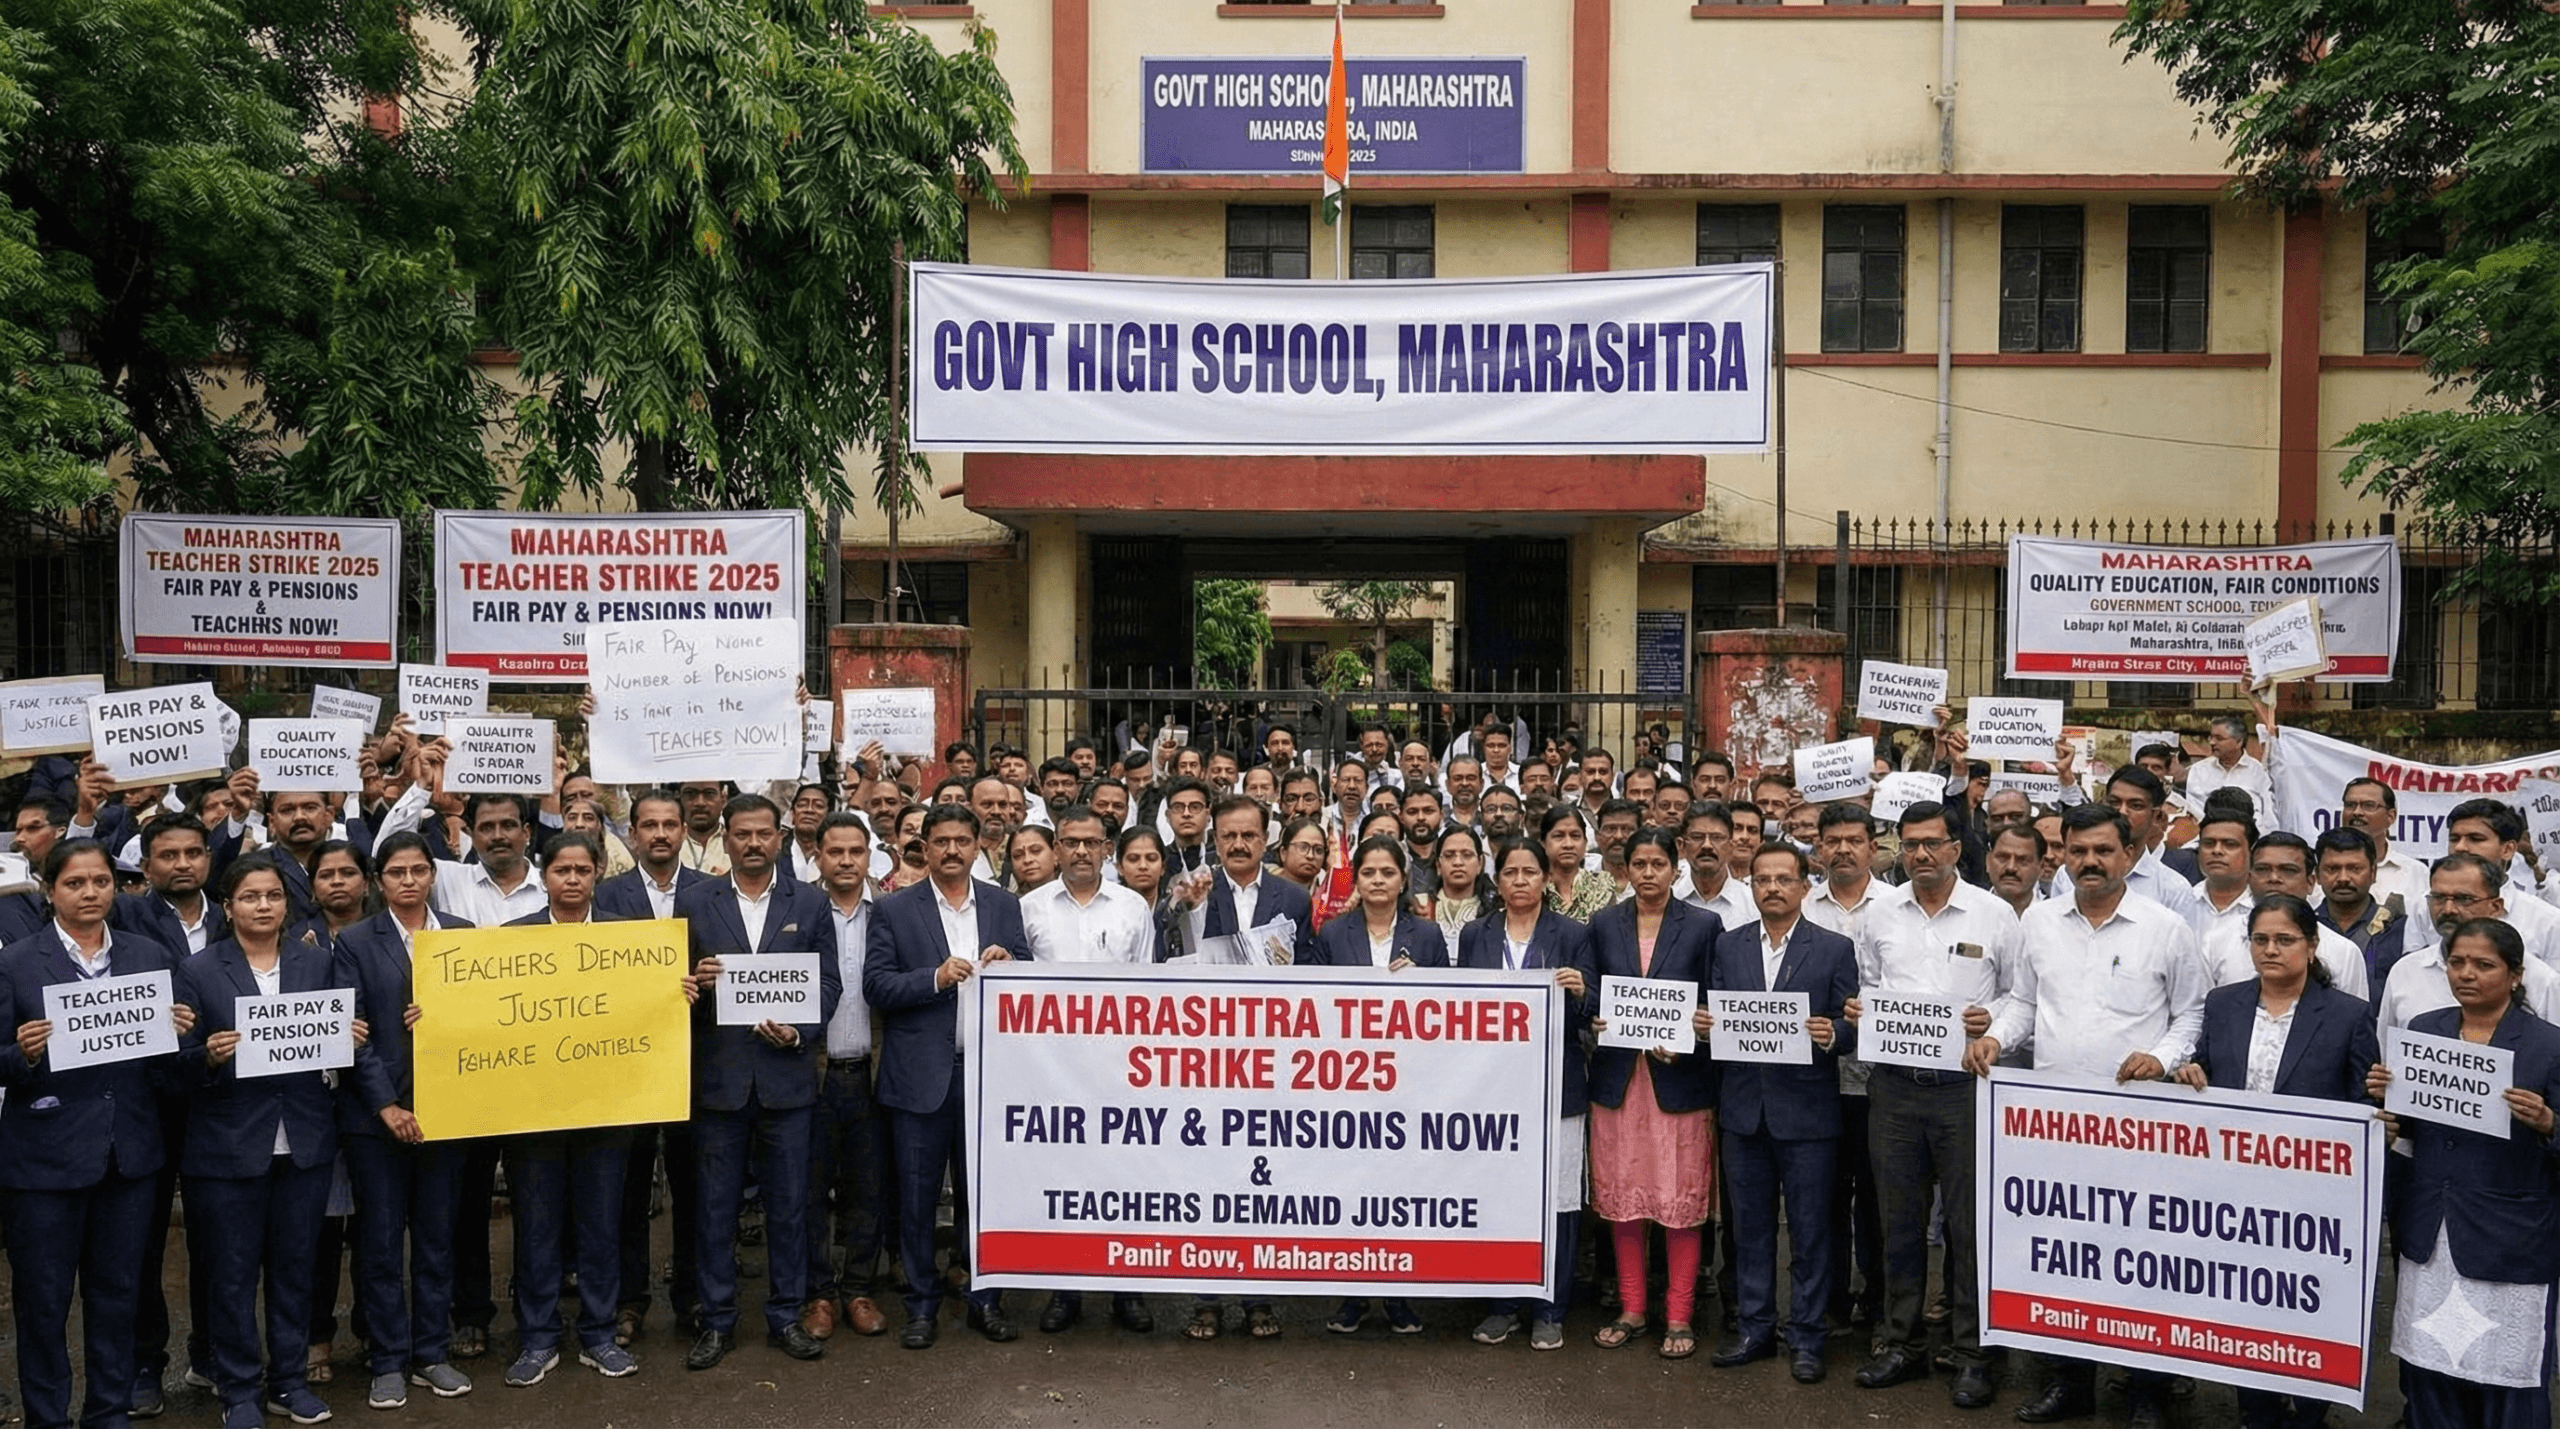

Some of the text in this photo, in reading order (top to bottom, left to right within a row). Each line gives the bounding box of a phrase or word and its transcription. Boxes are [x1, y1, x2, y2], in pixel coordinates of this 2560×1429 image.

[1154, 74, 1207, 107] GOVT
[1215, 75, 1264, 107] HIGH
[1362, 74, 1513, 108] MAHARASHTRA
[1375, 121, 1418, 141] INDIA
[933, 319, 1748, 402] GOVT HIGH SCHOOL, MAHARASHTRA
[184, 528, 341, 551] MAHARASHTRA
[510, 528, 727, 556] MAHARASHTRA
[146, 551, 379, 577] TEACHER STRIKE 2025
[2101, 552, 2312, 571] MAHARASHTRA
[459, 562, 780, 591] TEACHER STRIKE 2025
[2030, 574, 2380, 598] QUALITY EDUCATION, FAIR CONDITIONS
[164, 578, 358, 600] FAIR PAY & PENSIONS
[256, 600, 267, 615] &
[472, 602, 772, 622] FAIR PAY & PENSIONS NOW!
[2090, 599, 2181, 612] GOVERNMENT
[289, 618, 338, 636] NOW!
[407, 675, 479, 690] TEACHERS
[99, 694, 206, 721] FAIR PAY &
[412, 694, 472, 706] DEMAND
[719, 698, 744, 712] the
[1878, 699, 1923, 714] JUSTICE
[1989, 707, 2038, 718] QUALITY
[105, 719, 205, 745] PENSIONS
[277, 731, 336, 744] QUALITY
[647, 730, 722, 753] TEACHES
[734, 722, 787, 746] NOW!
[1979, 721, 2046, 733] EDUCATION,
[129, 745, 188, 767] NOW!
[260, 748, 351, 761] EDUCATIONS,
[458, 773, 542, 785] CONDITIONS
[433, 943, 677, 983] TEACHERS DEMAND
[727, 970, 809, 985] TEACHERS
[59, 983, 157, 1010] TEACHERS
[735, 990, 806, 1005] DEMAND
[1612, 984, 1686, 1003] TEACHERS
[248, 999, 344, 1020] FAIR PAY &
[498, 993, 610, 1026] JUSTICE
[1614, 1004, 1682, 1022] DEMAND
[1720, 999, 1798, 1015] TEACHERS
[1871, 999, 1953, 1019] TEACHERS
[68, 1006, 155, 1033] DEMAND
[998, 994, 1531, 1042] MAHARASHTRA TEACHER
[1722, 1019, 1799, 1035] PENSIONS
[250, 1021, 340, 1042] PENSIONS
[1618, 1024, 1676, 1041] JUSTICE
[1876, 1019, 1948, 1039] DEMAND
[268, 1044, 321, 1062] NOW!
[1738, 1039, 1784, 1054] NOW!
[1880, 1040, 1942, 1058] JUSTICE
[2401, 1041, 2496, 1073] TEACHERS
[1127, 1046, 1397, 1091] STRIKE 2025
[2405, 1066, 2490, 1096] DEMAND
[2410, 1091, 2482, 1118] JUSTICE
[1005, 1105, 1520, 1152] FAIR PAY & PENSIONS NOW!
[2004, 1106, 2353, 1176] MAHARASHTRA TEACHER
[1250, 1155, 1272, 1186] &
[1043, 1190, 1477, 1229] TEACHERS DEMAND JUSTICE
[2003, 1176, 2353, 1265] QUALITY EDUCATION,
[1252, 1247, 1414, 1273] Maharashtra
[2031, 1236, 2321, 1313] FAIR CONDITIONS
[2170, 1323, 2322, 1370] Maharashtra
